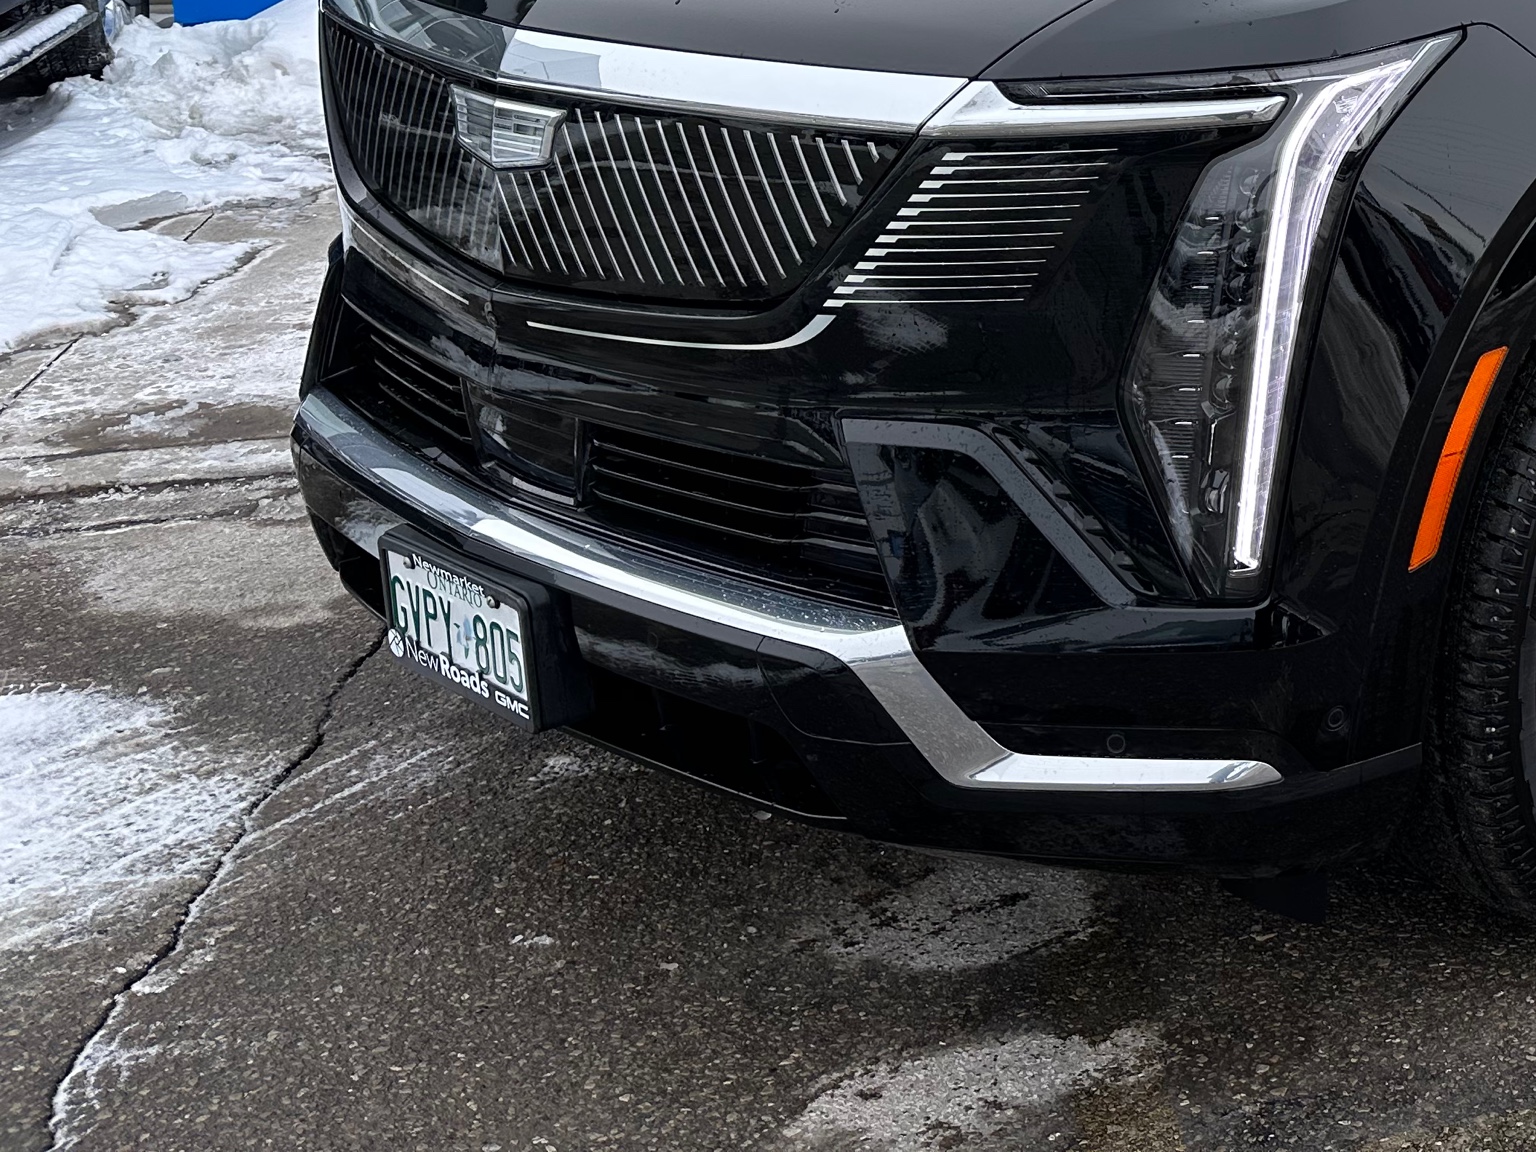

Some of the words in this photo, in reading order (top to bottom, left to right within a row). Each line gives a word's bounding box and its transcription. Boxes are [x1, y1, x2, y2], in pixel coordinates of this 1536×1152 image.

[412, 553, 486, 597] Newmarket
[427, 571, 483, 608] ONTARIO
[391, 574, 453, 661] GVPY
[472, 614, 524, 693] 805
[494, 691, 530, 720] GMC
